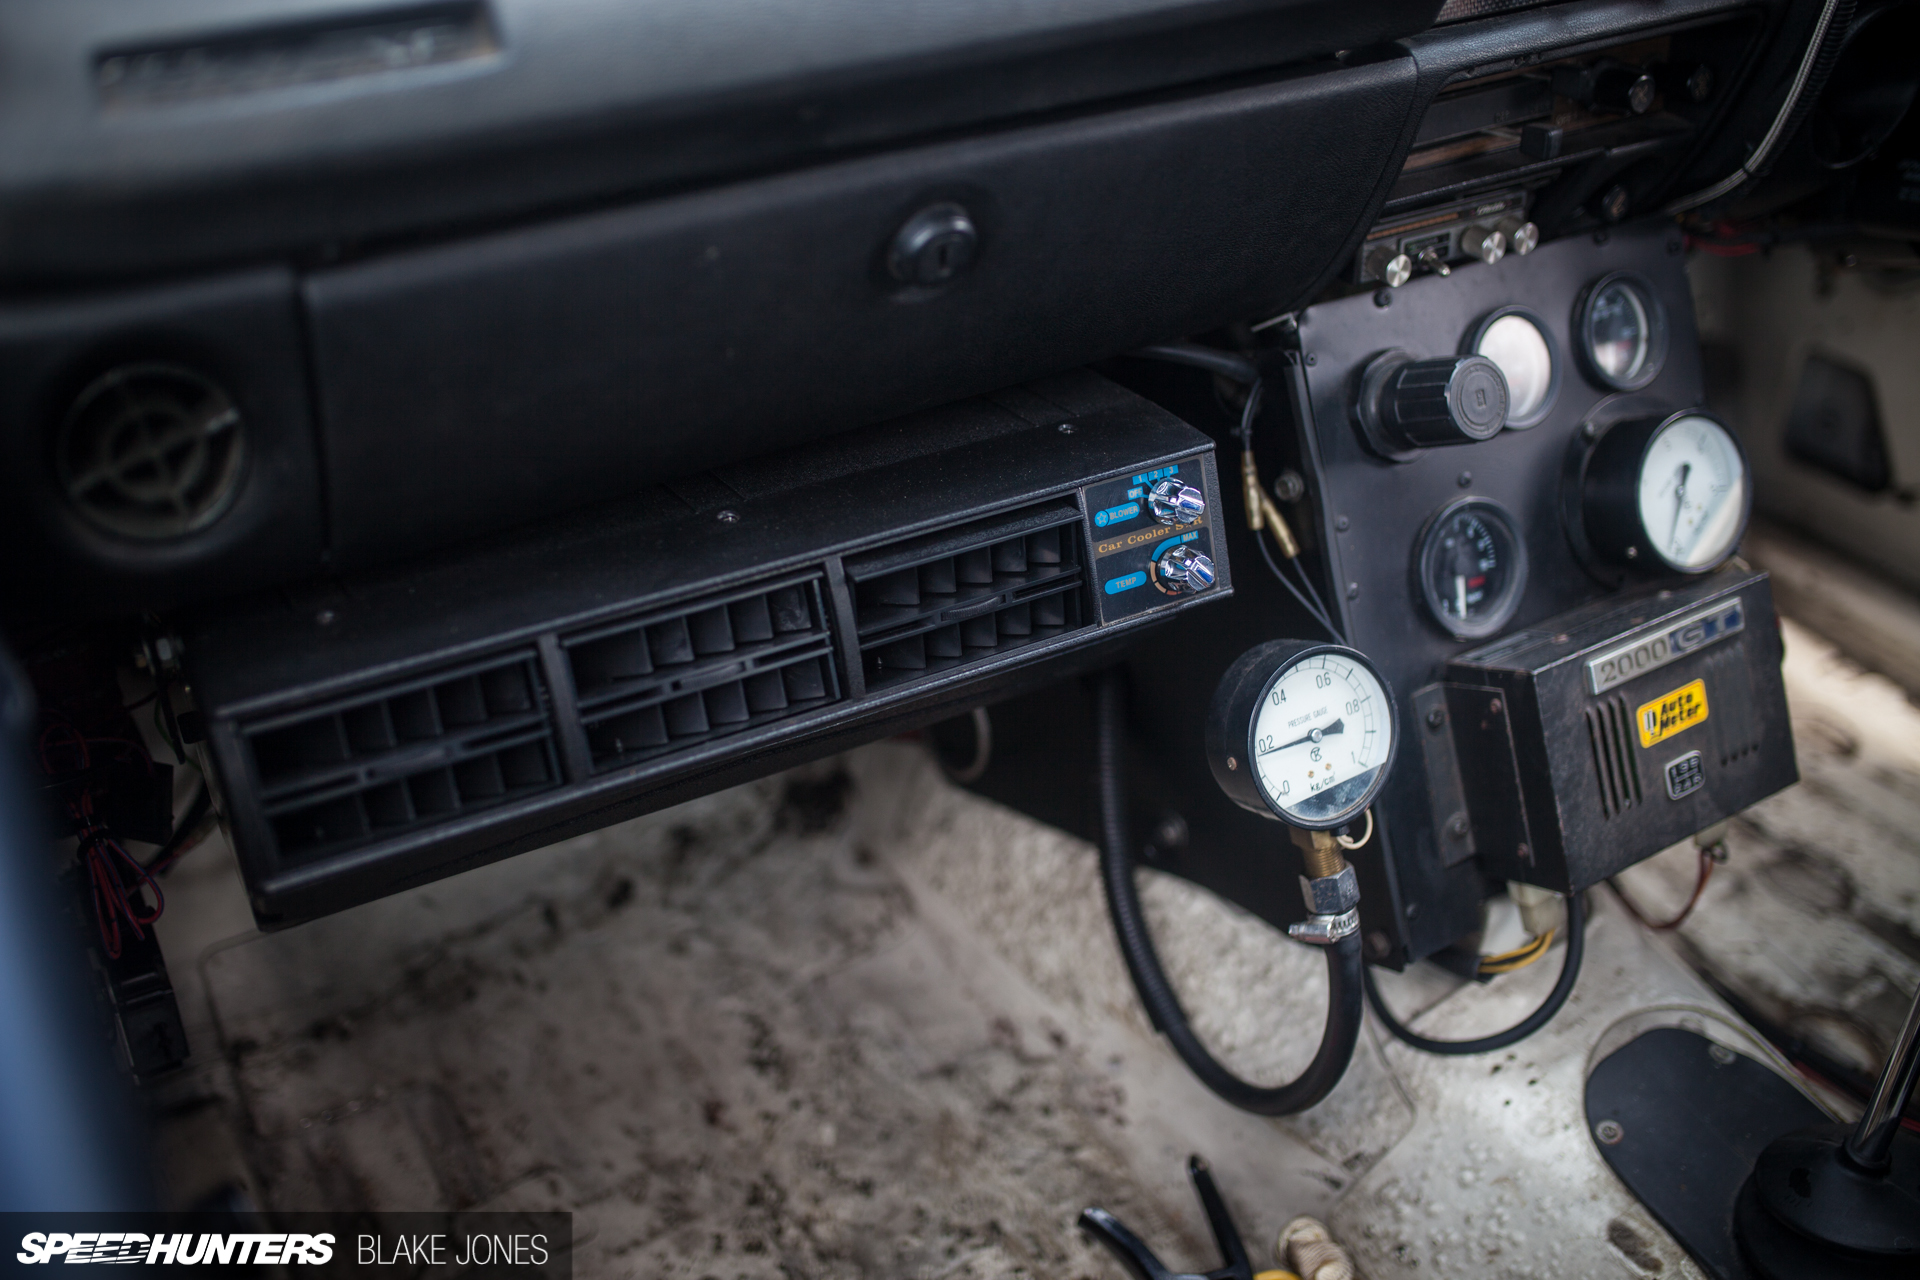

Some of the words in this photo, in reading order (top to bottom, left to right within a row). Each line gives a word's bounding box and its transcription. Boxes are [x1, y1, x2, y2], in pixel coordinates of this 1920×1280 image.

[1129, 487, 1142, 498] OFF
[1109, 505, 1139, 520] BLOWER
[1098, 540, 1123, 553] Car
[1127, 526, 1171, 545] Cooler
[1182, 531, 1198, 543] MAX
[1115, 576, 1137, 589] TEMP
[1315, 671, 1332, 689] 0.6
[1271, 688, 1287, 706] 0.4
[1661, 692, 1694, 716] Auto
[1345, 698, 1361, 716] 0.8
[1287, 711, 1313, 729] PRESSURE
[1313, 705, 1329, 719] GAUGE
[1659, 702, 1702, 736] Meter
[1258, 734, 1275, 753] 0.2
[1350, 751, 1356, 764] 1
[1282, 780, 1290, 795] 0
